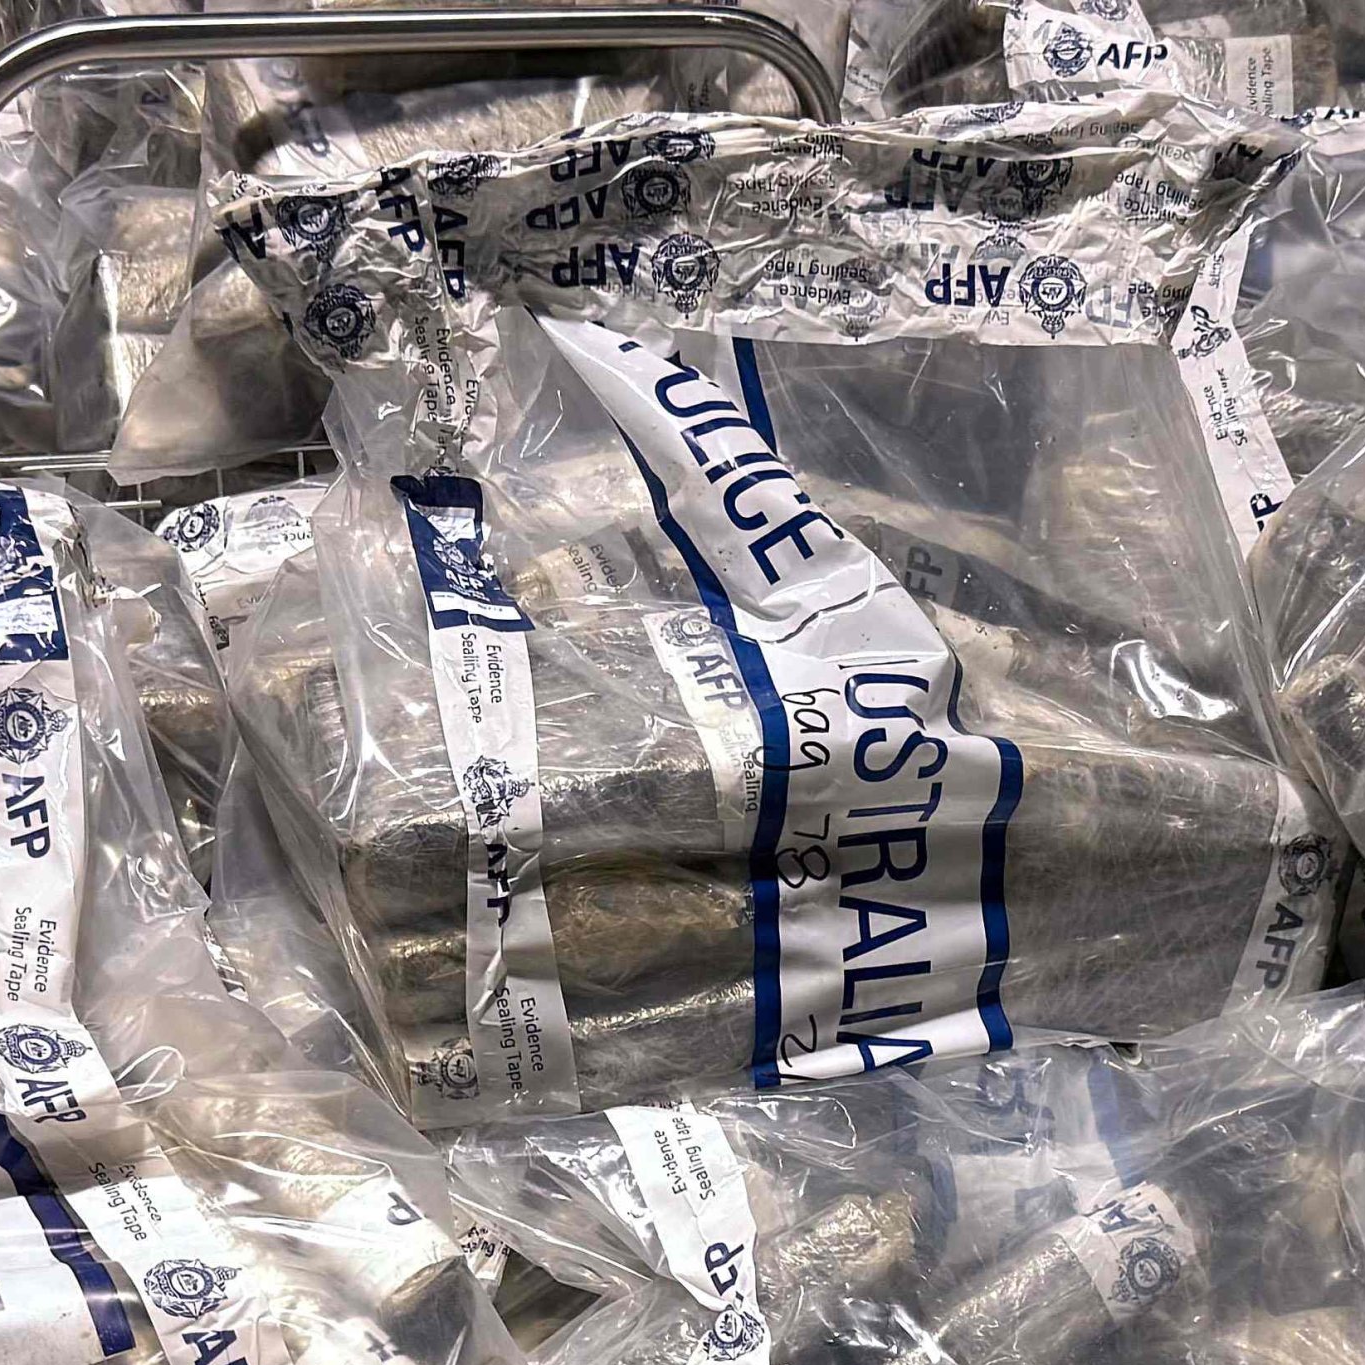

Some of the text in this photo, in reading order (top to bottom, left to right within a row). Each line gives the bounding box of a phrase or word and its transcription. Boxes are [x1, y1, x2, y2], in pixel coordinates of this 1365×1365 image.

[1096, 40, 1168, 70] AFP
[525, 187, 607, 231] AFP
[433, 205, 468, 299] AFP
[552, 243, 641, 288] AFP
[925, 262, 1011, 306] AFP
[778, 285, 850, 305] Evidence
[461, 632, 482, 723] Sealing Tape
[486, 643, 502, 705] Evidence
[686, 652, 745, 712] AFP
[1, 771, 50, 858] AFP
[775, 811, 831, 889] 78
[836, 658, 949, 1074] USTRALIA
[5, 905, 32, 1002] Sealing Tape
[33, 918, 58, 995] Evidence
[1255, 903, 1304, 990] AFP
[495, 987, 523, 1090] Sealing Tape
[519, 997, 544, 1072] Evidence
[15, 1076, 87, 1123] AFP
[655, 1128, 688, 1195] Evidence
[89, 1161, 149, 1241] Sealing Tape
